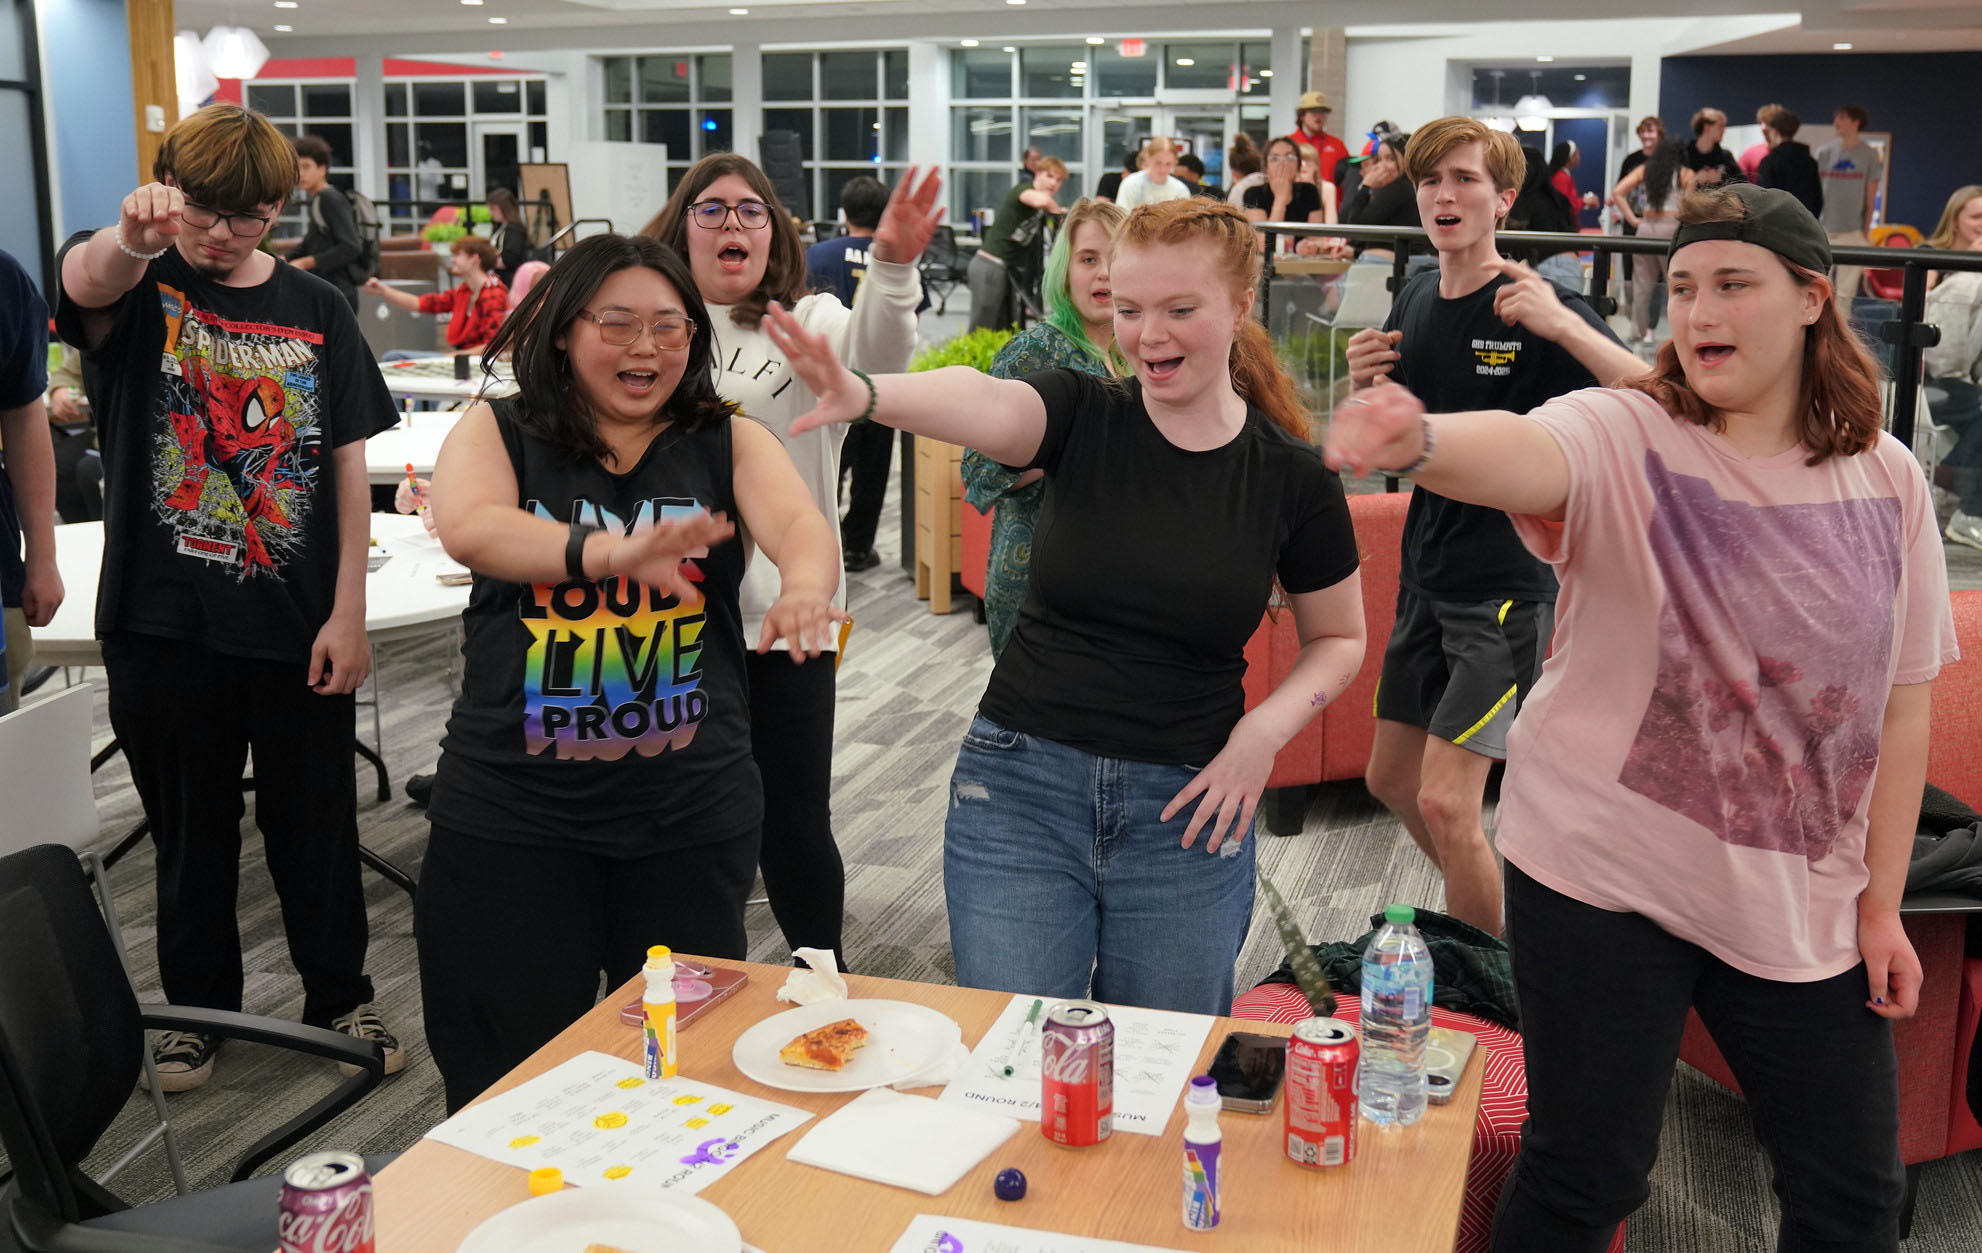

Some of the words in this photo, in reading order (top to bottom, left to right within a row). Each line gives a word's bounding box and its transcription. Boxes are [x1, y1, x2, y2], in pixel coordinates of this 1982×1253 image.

[182, 535, 236, 555] TORMENT
[541, 612, 706, 697] LIVE
[541, 689, 709, 741] PROUD
[965, 1092, 1017, 1105] ROUND
[744, 1112, 780, 1135] MUSIC
